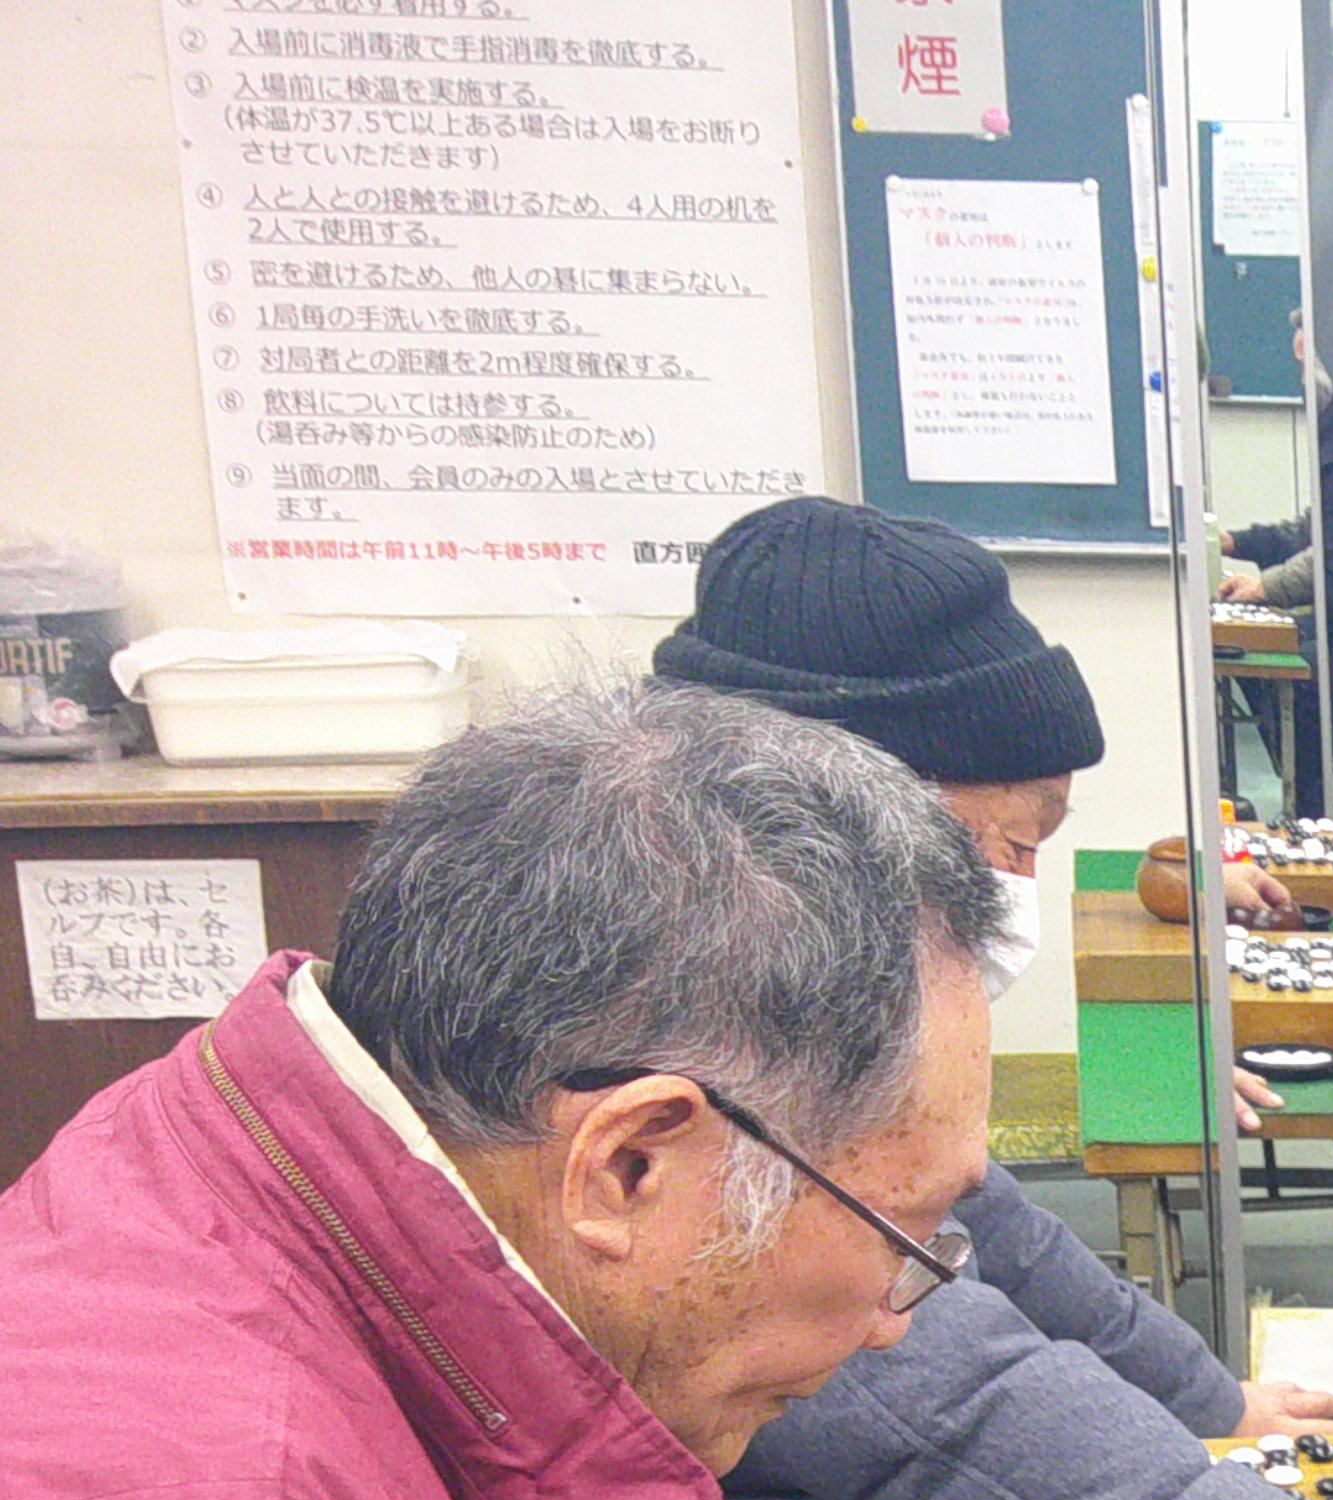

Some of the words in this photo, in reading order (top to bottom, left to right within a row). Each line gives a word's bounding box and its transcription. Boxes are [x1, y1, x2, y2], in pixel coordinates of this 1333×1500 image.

[229, 27, 708, 69] 入場前に消毒液で手指消毒を徹底する。
[234, 72, 549, 106] 入場前に検温を実施する。
[244, 183, 777, 222] 人と人との接触を避けるため、4人用の机を
[249, 217, 441, 246] 2人で使用する。
[250, 260, 751, 296] 密を避けるため、他人の碁に集まらない。
[258, 302, 582, 334] 1局毎の手洗いを徹底する。
[261, 346, 694, 377] 対局者との距離を2m程度確保する。
[263, 388, 573, 418] 飲料については持参する。
[273, 464, 805, 493] 当面の間、会員のみの入場とさせていただき
[277, 496, 344, 519] ます。
